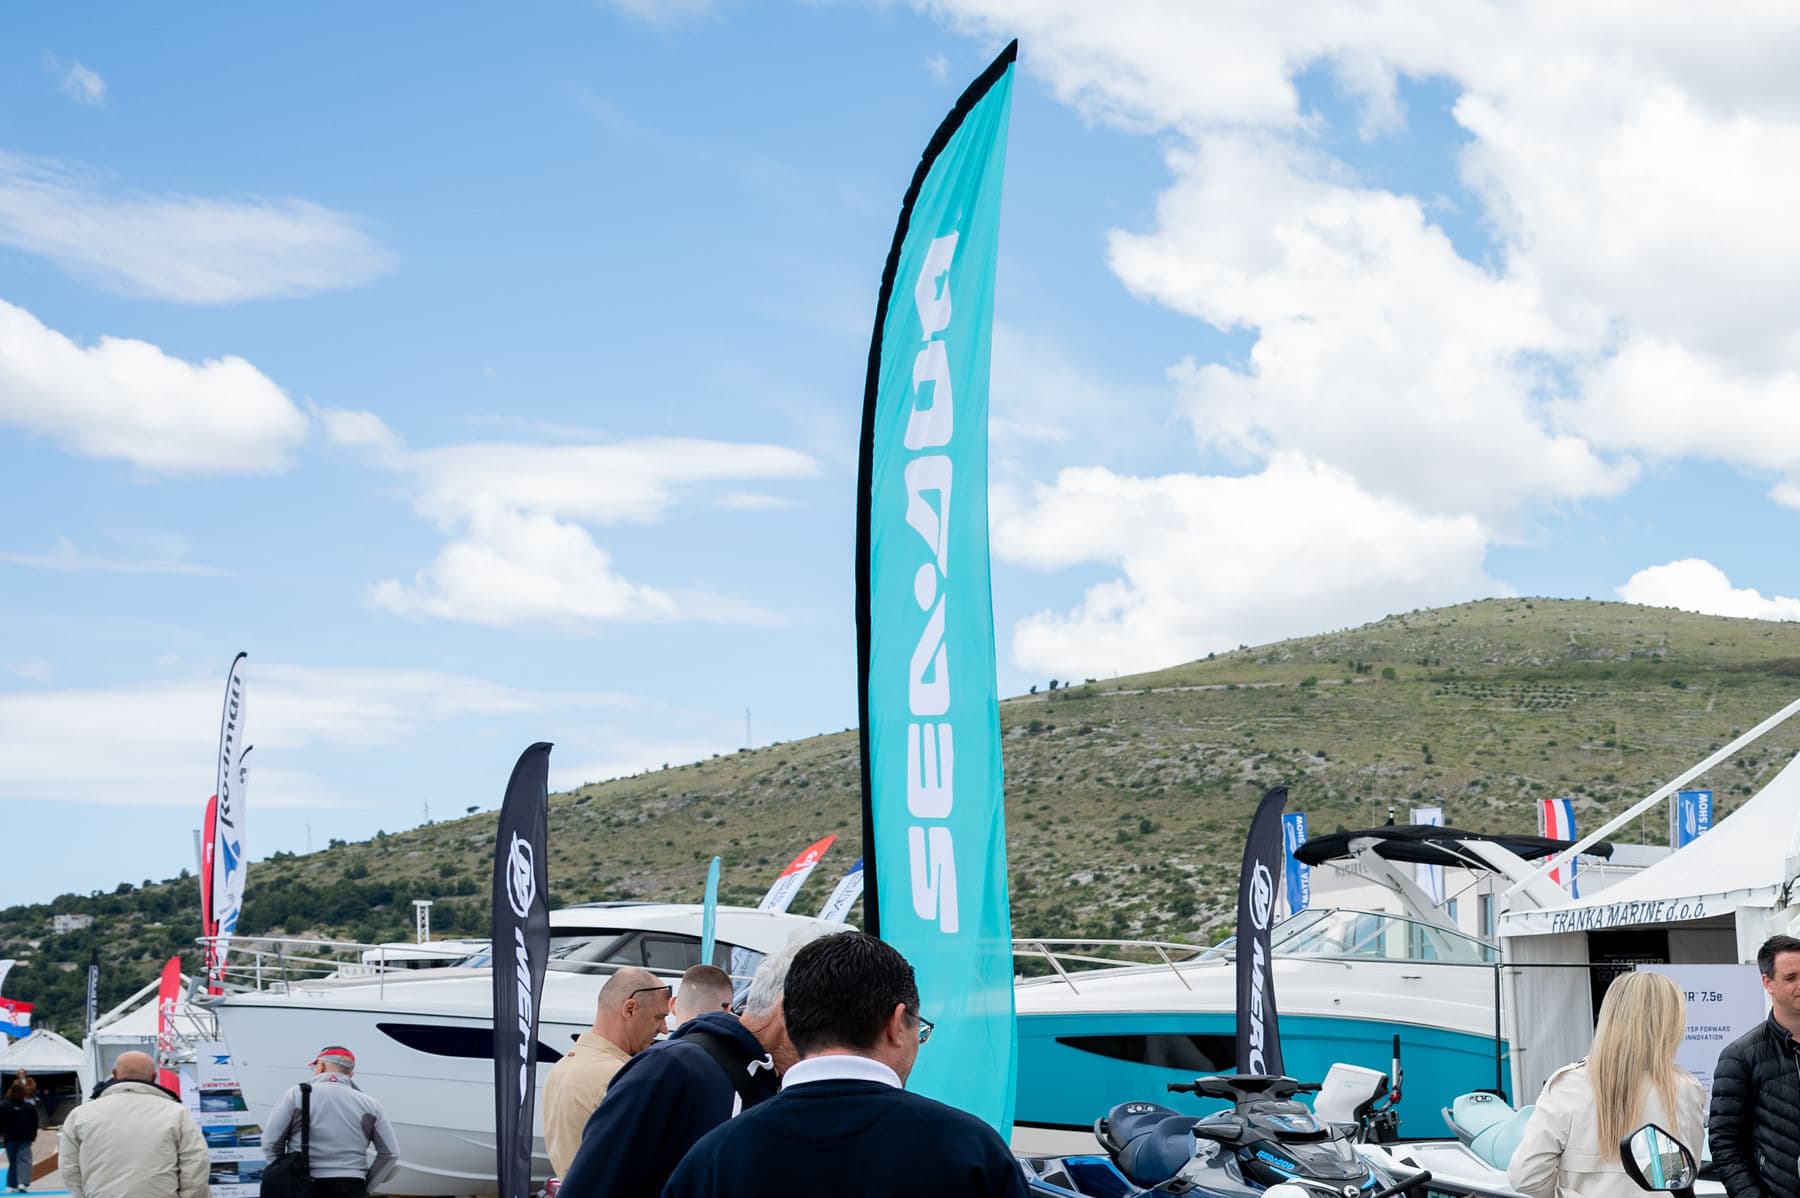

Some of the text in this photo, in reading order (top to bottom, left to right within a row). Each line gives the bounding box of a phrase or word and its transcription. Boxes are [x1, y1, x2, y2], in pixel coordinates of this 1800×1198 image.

[219, 676, 241, 829] Rodman
[1698, 793, 1709, 824] SHOW
[1295, 815, 1304, 845] SHOW
[1552, 907, 1603, 934] FRANKA
[1607, 902, 1664, 927] MARINE
[1250, 937, 1267, 1077] MERC
[1701, 991, 1723, 1002] 7.5e
